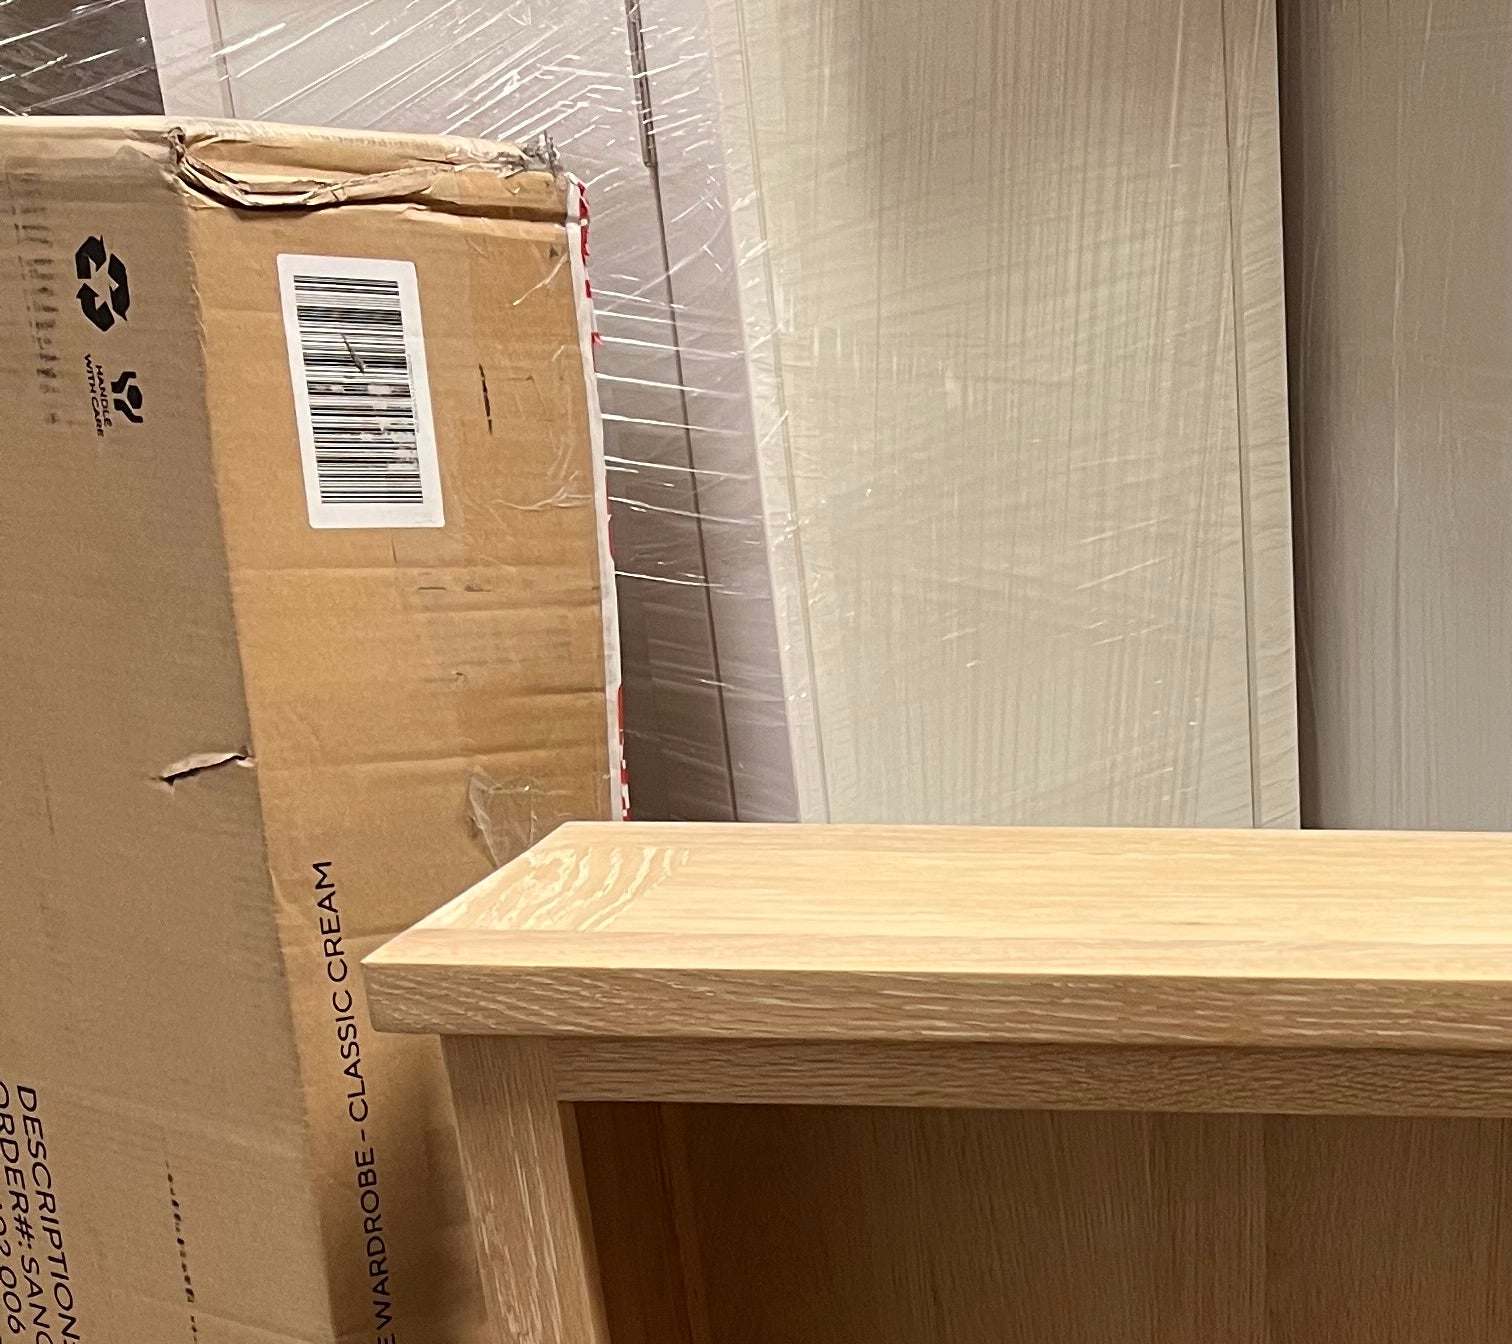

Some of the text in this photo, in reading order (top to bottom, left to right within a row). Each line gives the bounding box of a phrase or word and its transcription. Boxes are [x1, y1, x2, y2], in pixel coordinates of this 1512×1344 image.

[84, 353, 105, 438] WITH CARE
[95, 364, 113, 427] HANDLE
[311, 861, 348, 983] CREAM
[332, 989, 369, 1124] CLASSIC
[0, 1080, 36, 1250] ORDER#:
[354, 1146, 393, 1331] WARDROBE
